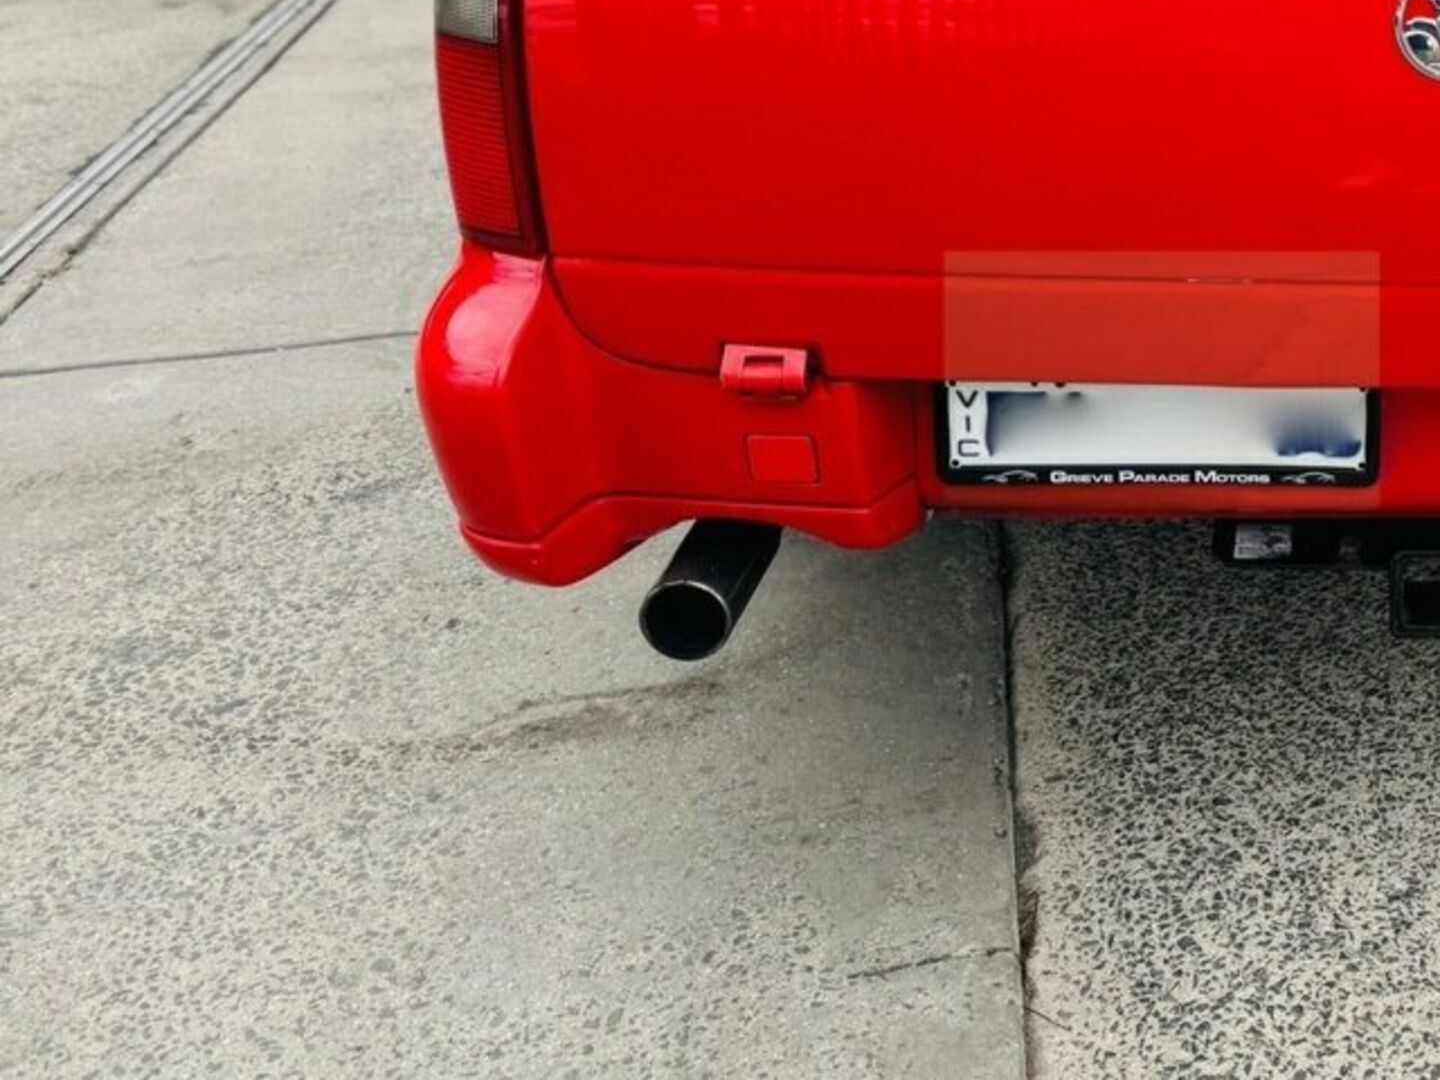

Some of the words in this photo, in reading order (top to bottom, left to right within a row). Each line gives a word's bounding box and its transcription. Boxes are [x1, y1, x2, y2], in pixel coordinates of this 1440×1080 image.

[956, 390, 981, 458] VIC
[1049, 470, 1114, 484] GRIEVE
[1118, 470, 1191, 484] PARADE
[1194, 470, 1271, 484] MOTORS
